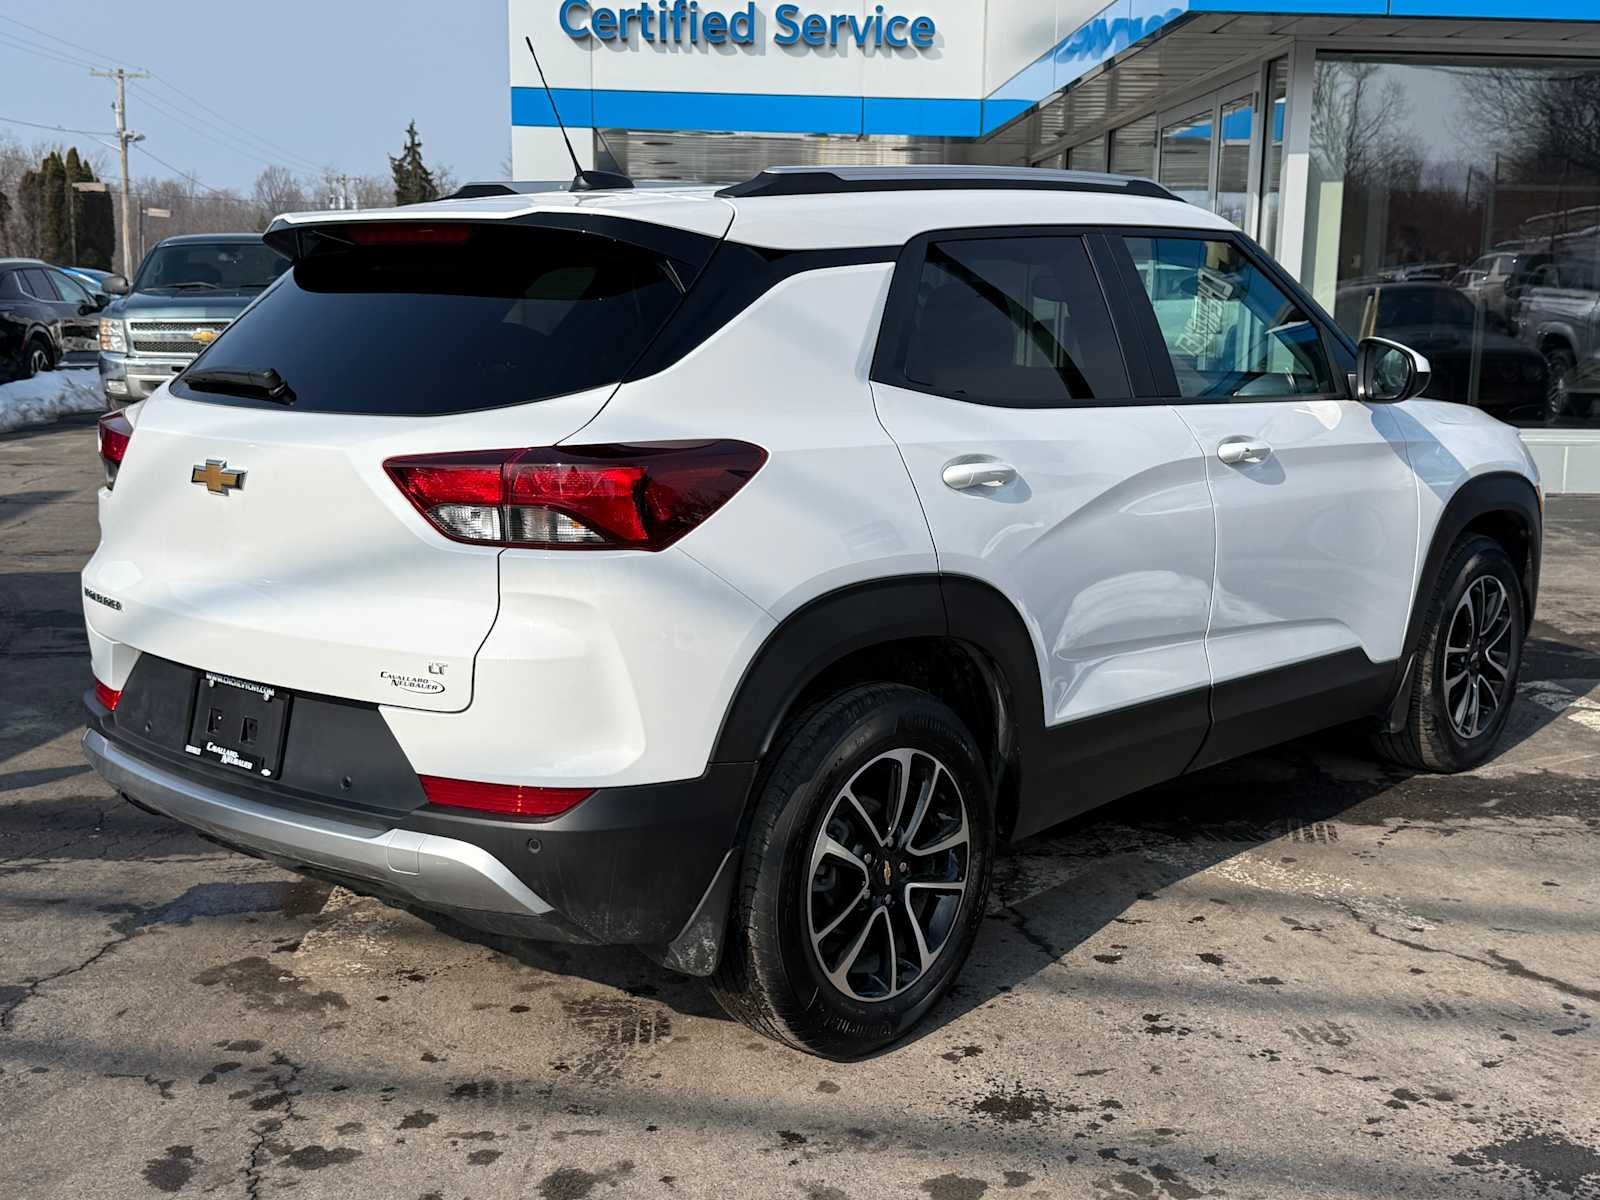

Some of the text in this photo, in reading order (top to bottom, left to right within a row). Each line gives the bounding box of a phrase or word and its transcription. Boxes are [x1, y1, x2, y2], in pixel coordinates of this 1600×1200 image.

[559, 0, 936, 48] Certified Service
[428, 662, 448, 675] LT
